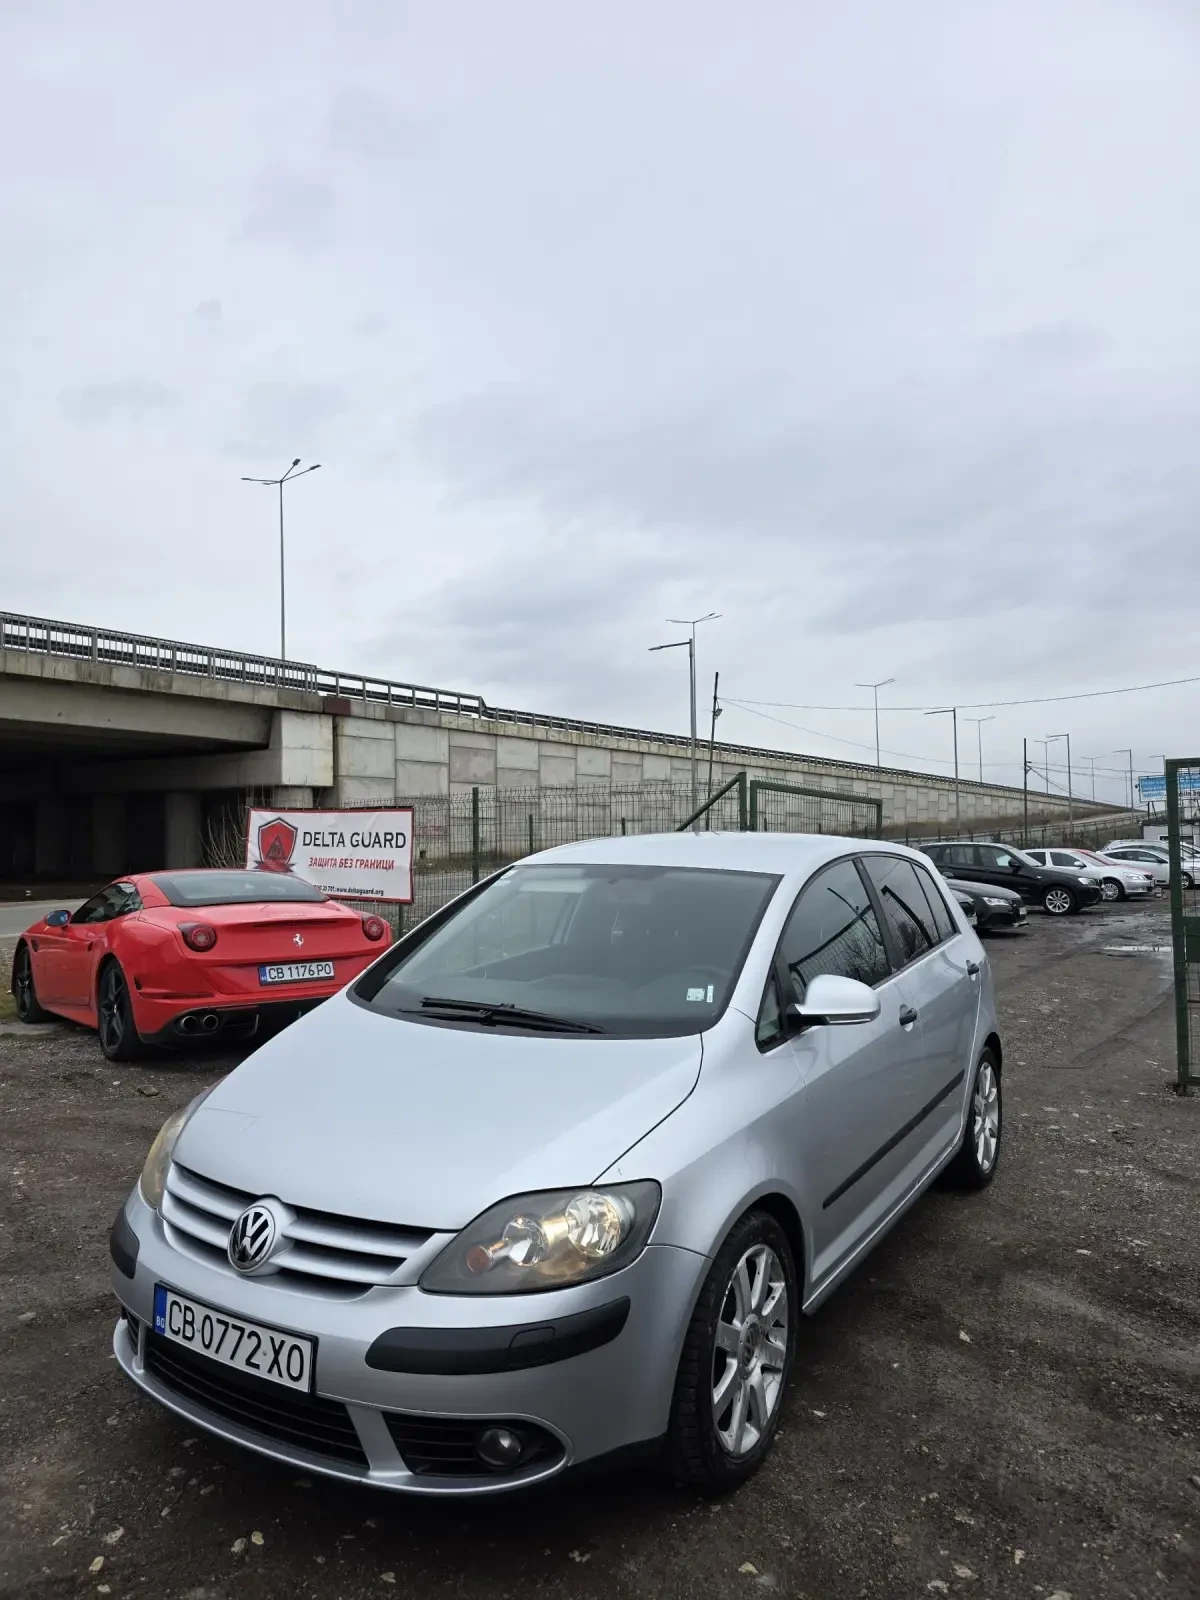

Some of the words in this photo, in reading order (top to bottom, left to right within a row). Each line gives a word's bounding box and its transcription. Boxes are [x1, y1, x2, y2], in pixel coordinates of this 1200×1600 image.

[303, 831, 346, 848] DELTA
[350, 832, 406, 849] GUARD
[308, 857, 338, 868] ЗАЩИТА
[338, 858, 353, 868] БЕЗ
[355, 858, 395, 871] ГРАНИЦИ
[268, 967, 285, 980] CB
[288, 965, 315, 978] 1176
[155, 1315, 165, 1329] BG
[169, 1299, 196, 1342] CB
[201, 1314, 262, 1370] 0772
[267, 1335, 305, 1382] XO
